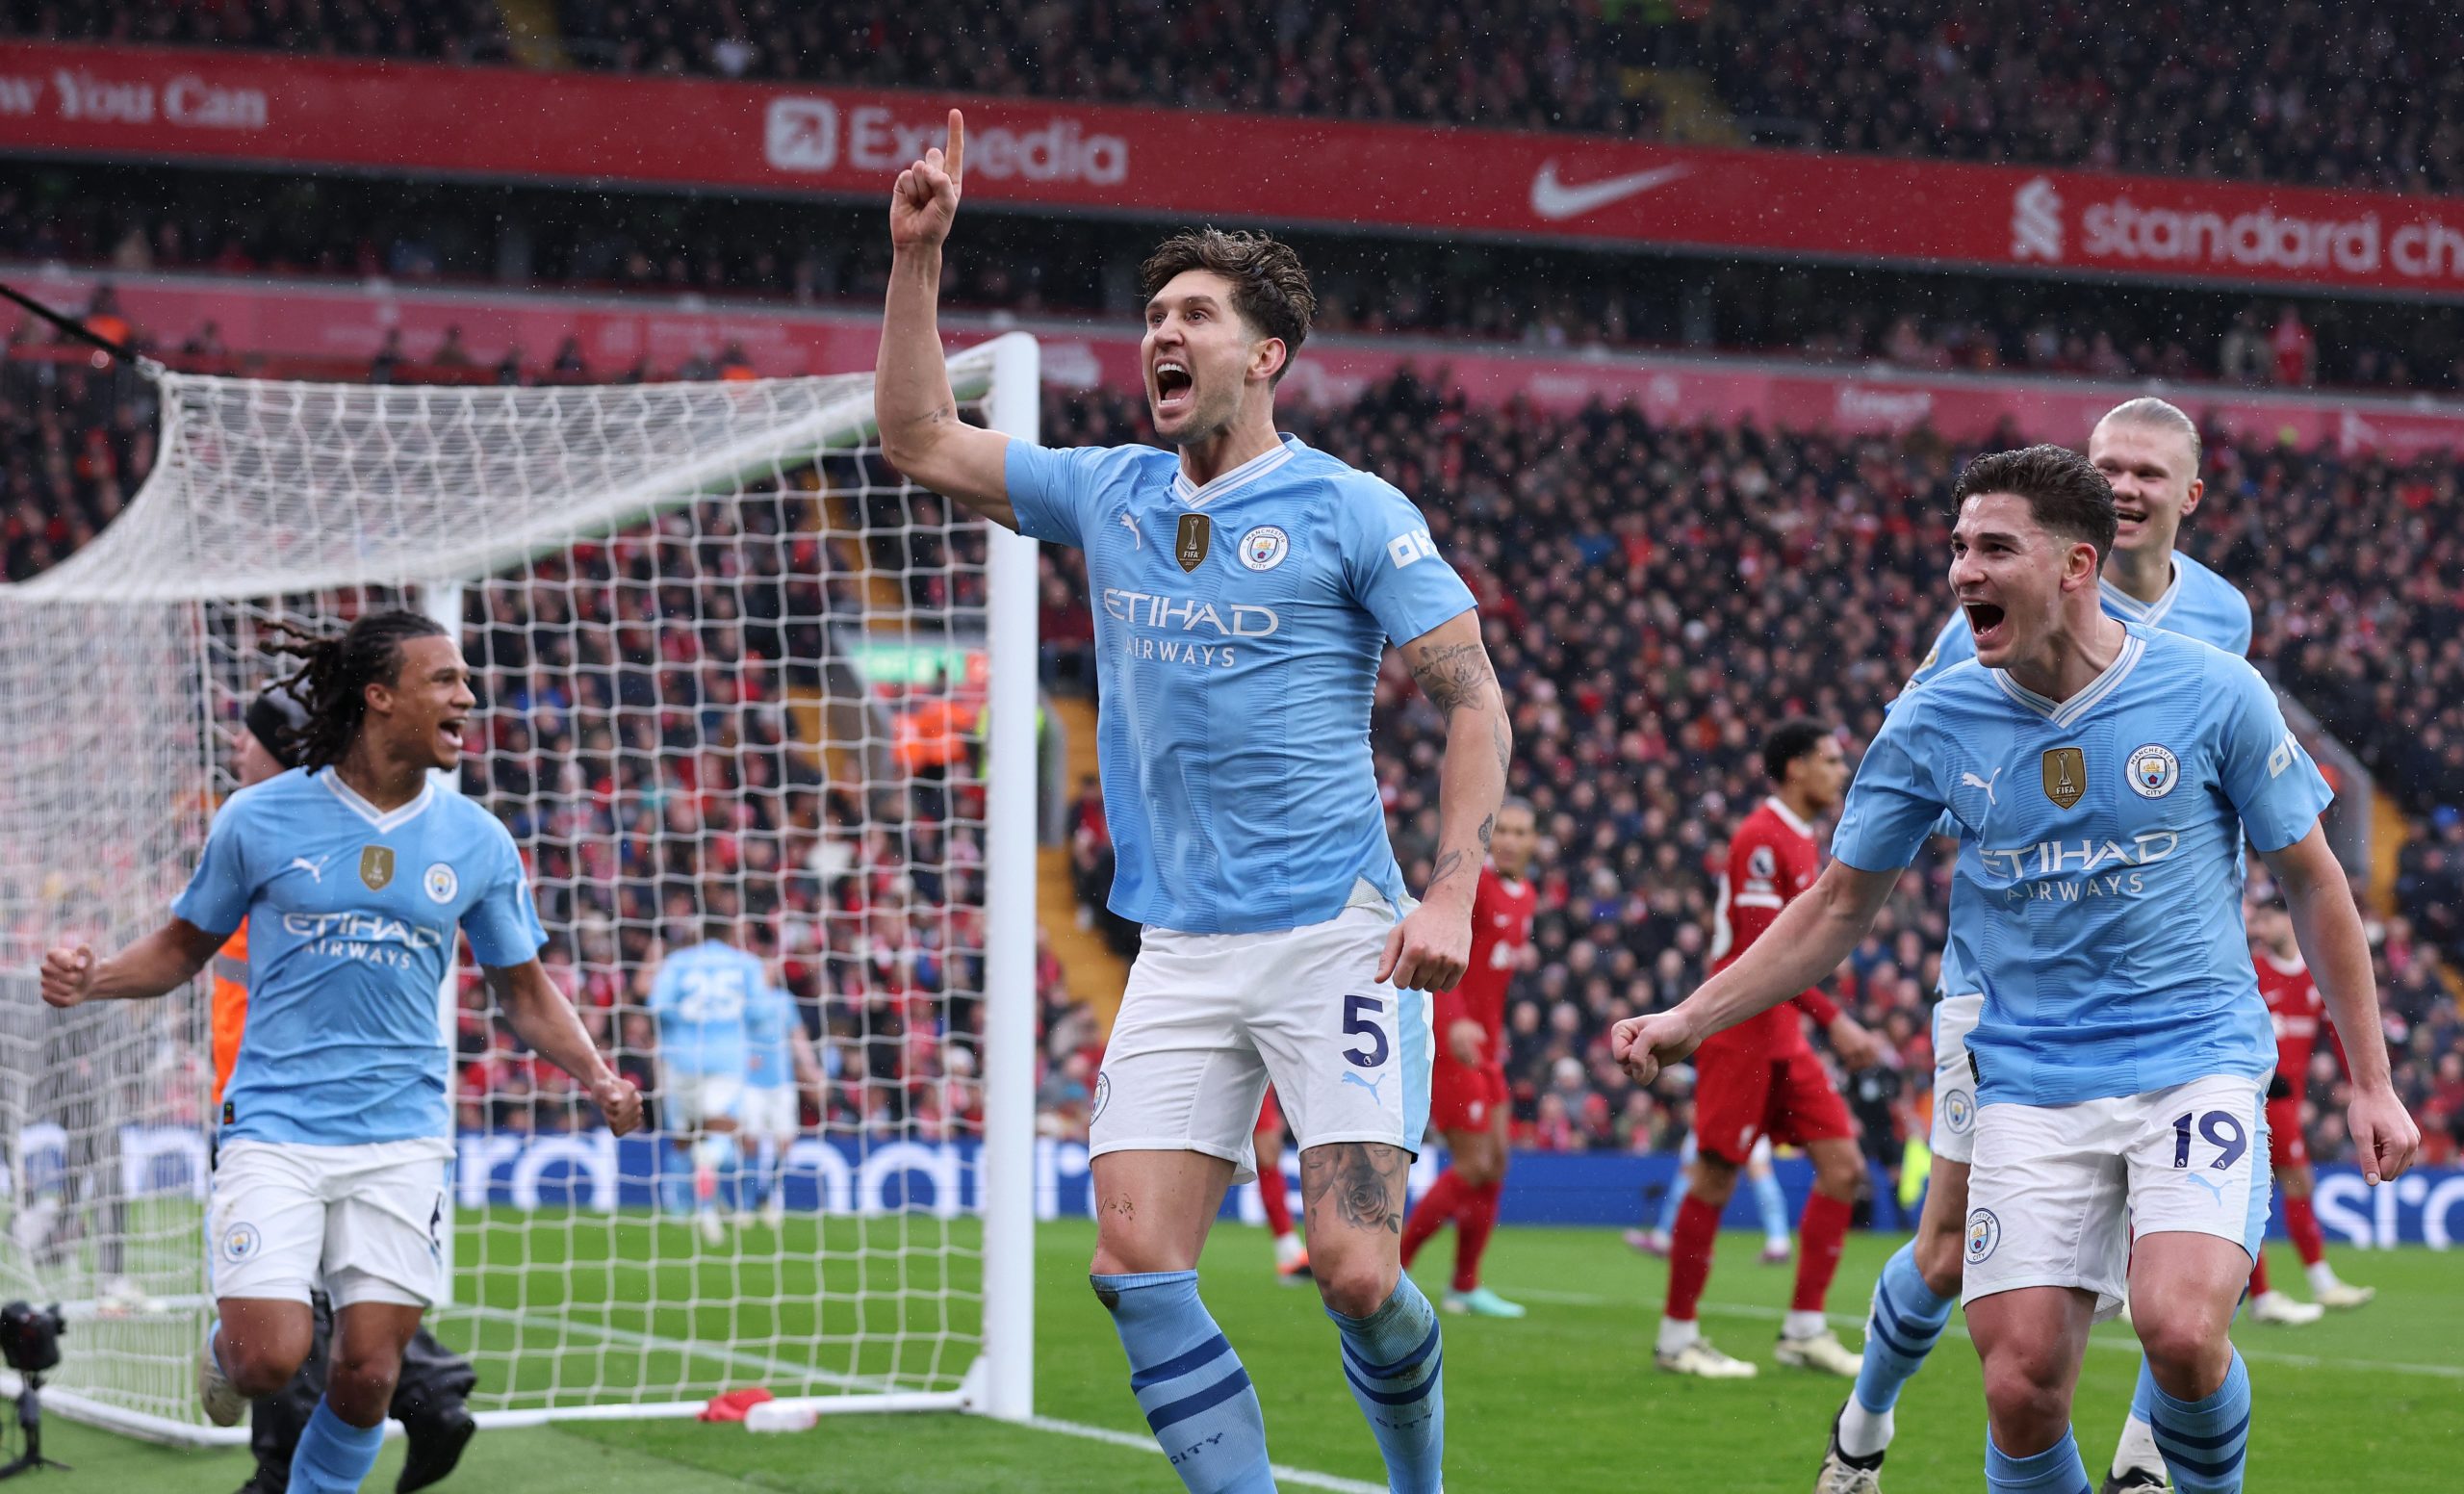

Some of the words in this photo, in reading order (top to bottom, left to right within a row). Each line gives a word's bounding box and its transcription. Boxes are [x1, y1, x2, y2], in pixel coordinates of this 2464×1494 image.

[53, 68, 154, 124] You
[162, 72, 269, 129] Can
[2083, 196, 2381, 274] standard
[1104, 587, 1279, 637] ETIHAD
[1125, 635, 1235, 668] AIRWAYS
[2130, 747, 2174, 765] MANCHESTER
[2056, 786, 2075, 795] FIFA
[1979, 831, 2178, 879] ETIHAD
[2007, 872, 2144, 902] AIRWAYS
[283, 913, 442, 948] ETIHAD
[302, 929, 411, 970] AIRWAYS
[680, 969, 745, 1022] 25
[1342, 994, 1390, 1068] 5
[2172, 1110, 2247, 1172] 19
[1973, 1252, 1986, 1261] CITY
[1169, 1431, 1223, 1465] CITY
